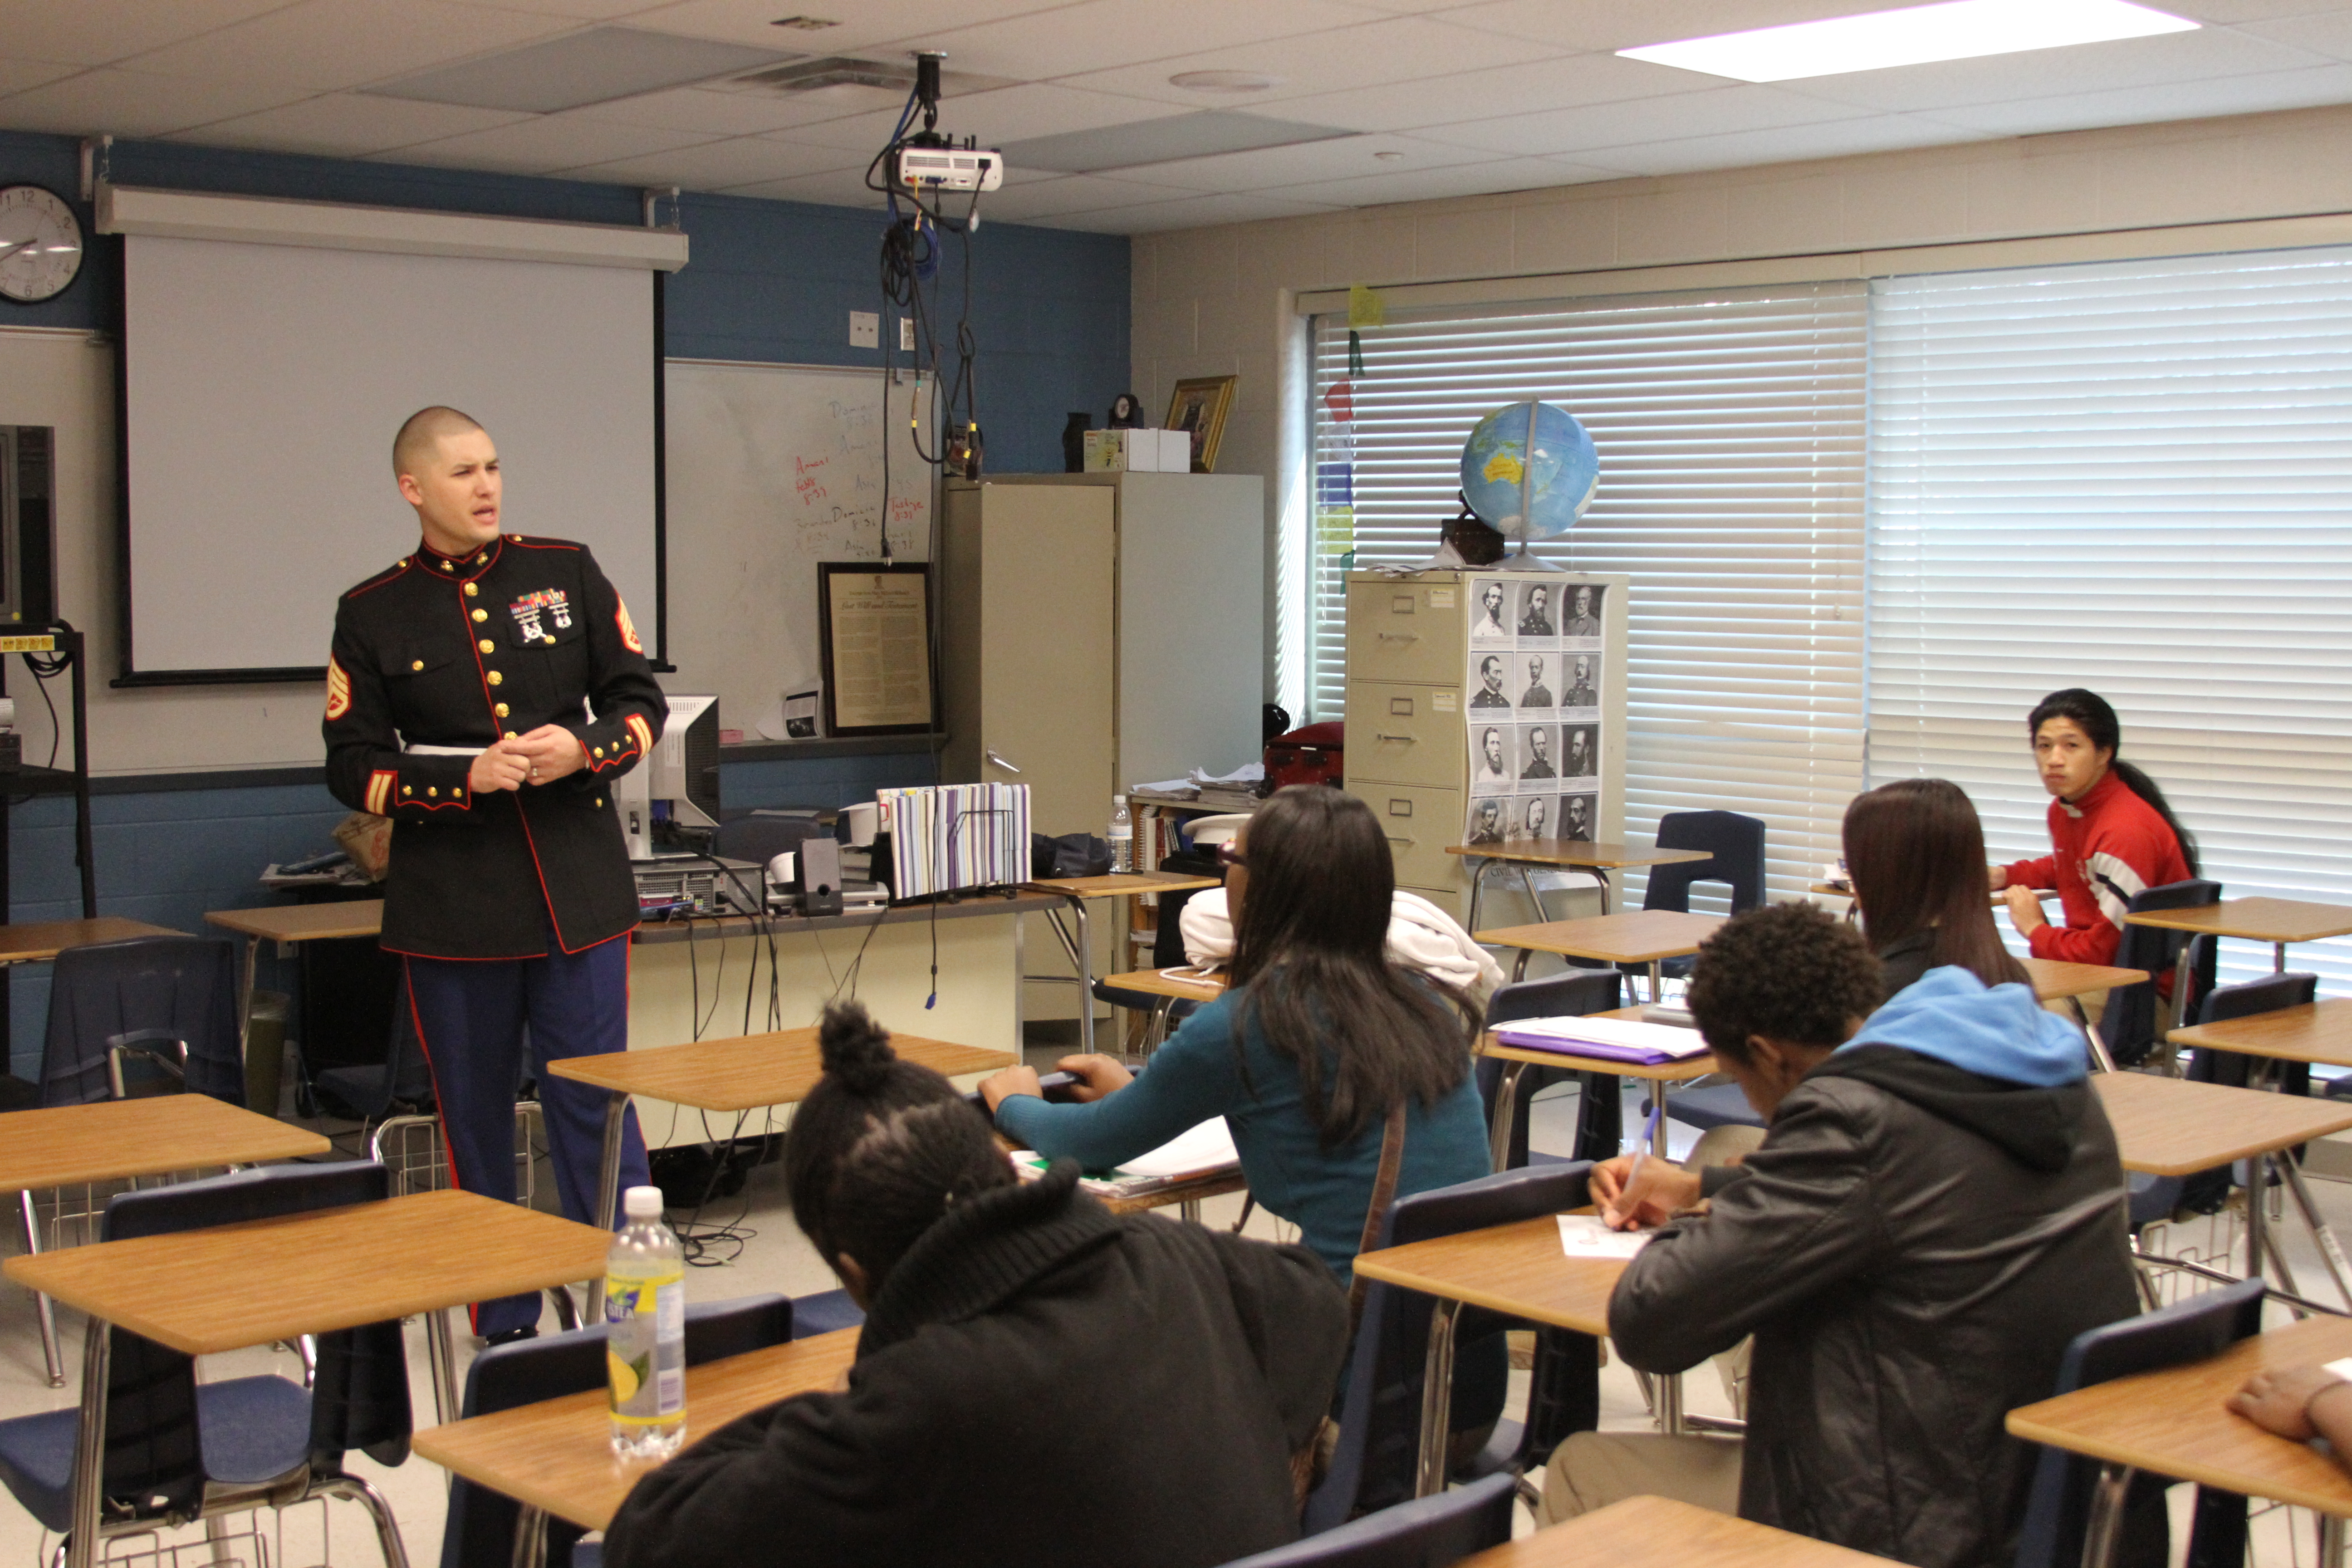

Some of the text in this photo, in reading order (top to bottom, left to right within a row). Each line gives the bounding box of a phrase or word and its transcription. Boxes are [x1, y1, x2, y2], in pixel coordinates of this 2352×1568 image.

[21, 191, 34, 202] 12
[48, 199, 54, 210] 1
[64, 216, 71, 229] 2
[63, 263, 69, 274] 4
[24, 285, 32, 297] 6
[48, 280, 54, 291] 5
[872, 601, 885, 609] and
